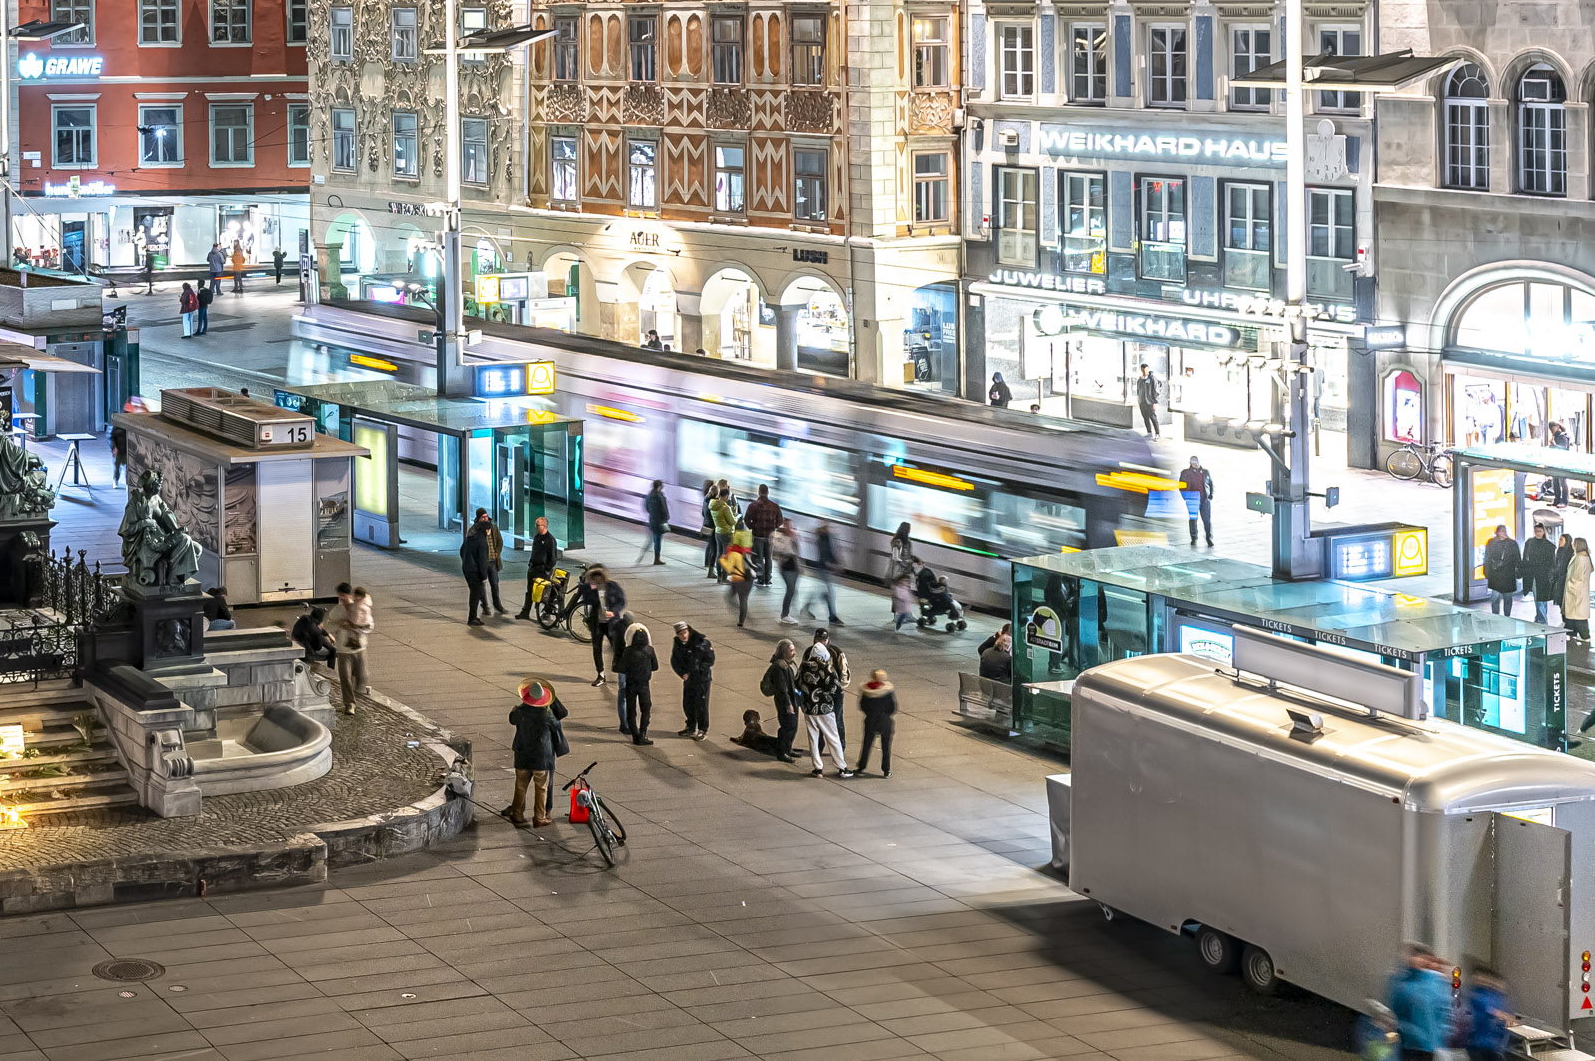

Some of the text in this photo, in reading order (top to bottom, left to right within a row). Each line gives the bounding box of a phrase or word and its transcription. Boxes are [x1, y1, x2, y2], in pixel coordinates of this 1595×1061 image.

[45, 58, 103, 75] GRAWE
[1039, 130, 1287, 161] WEIKHARD HAUS
[629, 231, 659, 247] AUER
[792, 248, 828, 264] LUSH
[988, 269, 1106, 294] JUWELIER
[1068, 309, 1232, 345] WEIKHARD
[287, 427, 307, 443] 15
[1261, 618, 1292, 633] TICKETS
[1314, 630, 1346, 645] TICKETS
[1374, 644, 1407, 659] TICKETS
[1444, 645, 1473, 657] TICKETS
